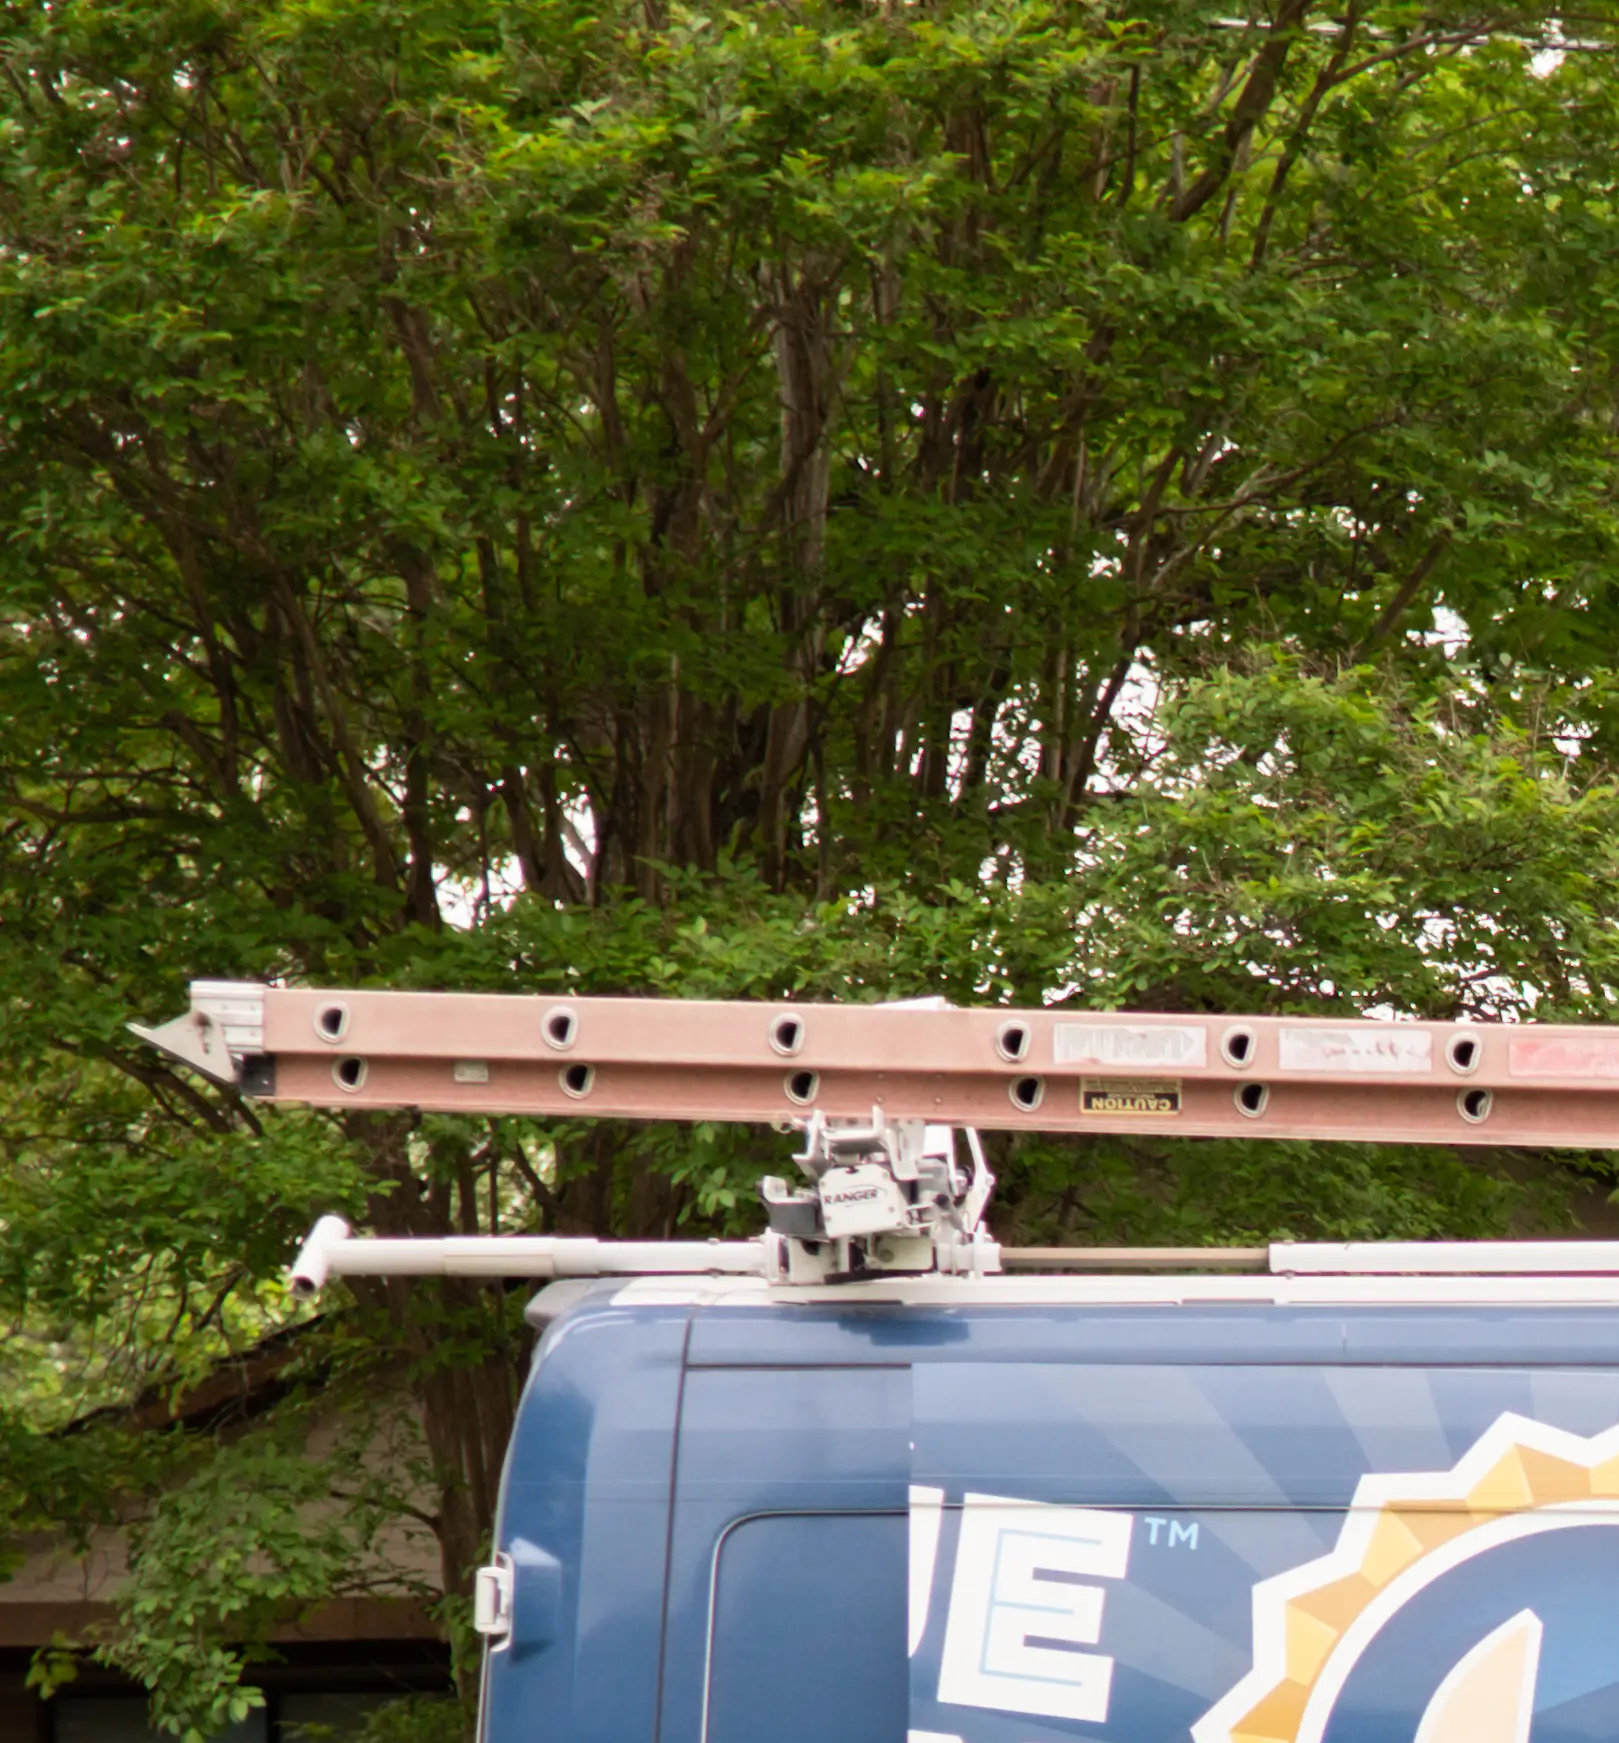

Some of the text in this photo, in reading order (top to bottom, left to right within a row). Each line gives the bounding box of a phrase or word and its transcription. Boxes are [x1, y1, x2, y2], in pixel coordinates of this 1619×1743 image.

[1091, 1097, 1172, 1111] CAUTION
[823, 1188, 878, 1205] RANGER
[1143, 1516, 1200, 1551] TM
